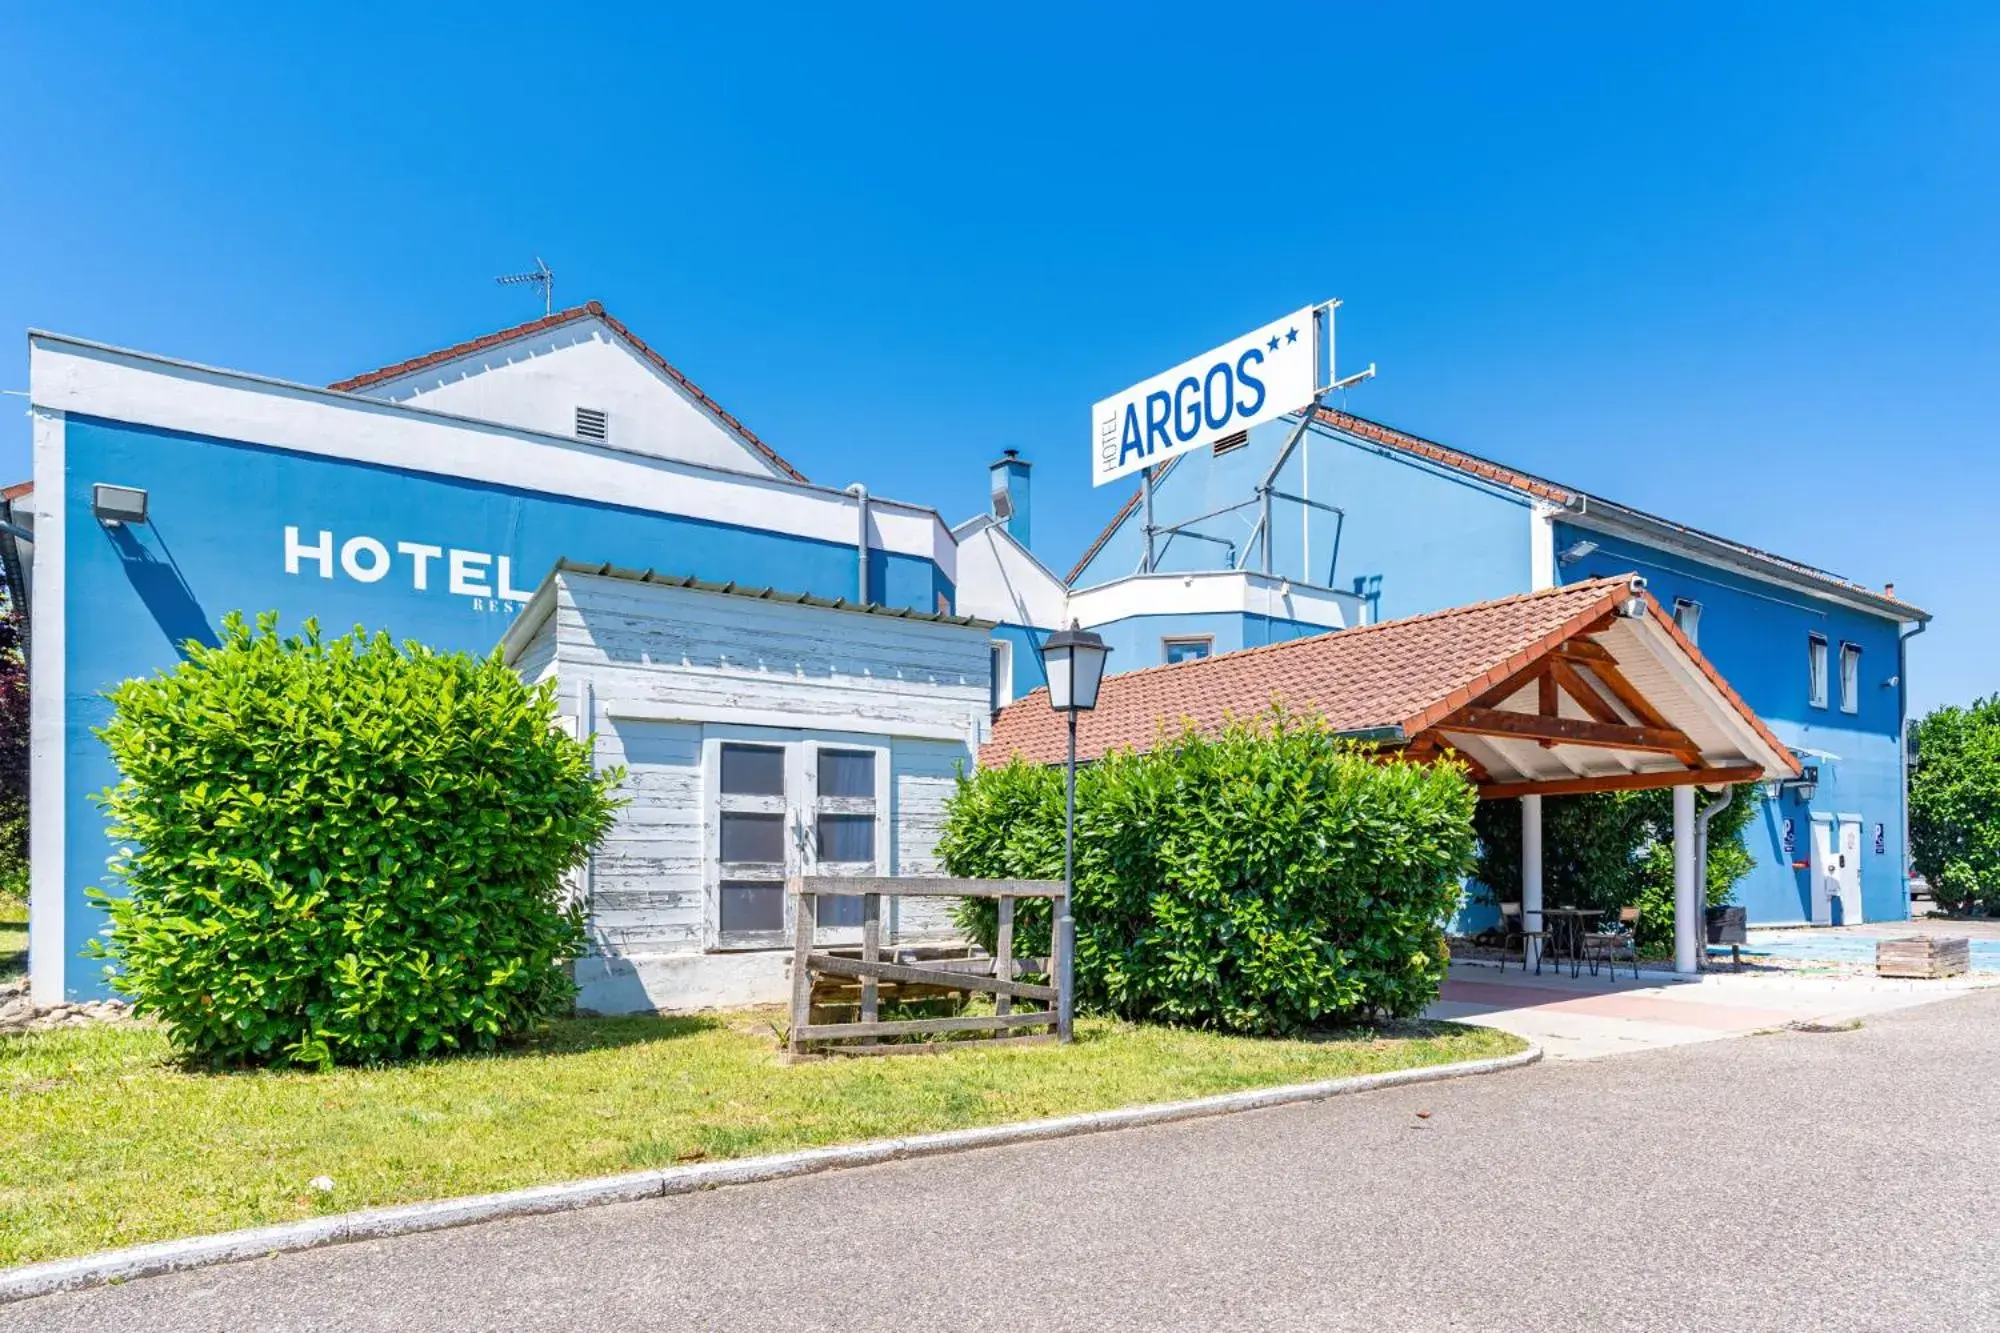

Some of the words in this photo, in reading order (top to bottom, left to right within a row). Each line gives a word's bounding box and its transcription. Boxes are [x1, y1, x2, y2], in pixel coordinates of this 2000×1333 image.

[1102, 410, 1117, 473] HOTEL
[1119, 348, 1266, 467] ARGOS
[284, 526, 534, 602] HOTEL
